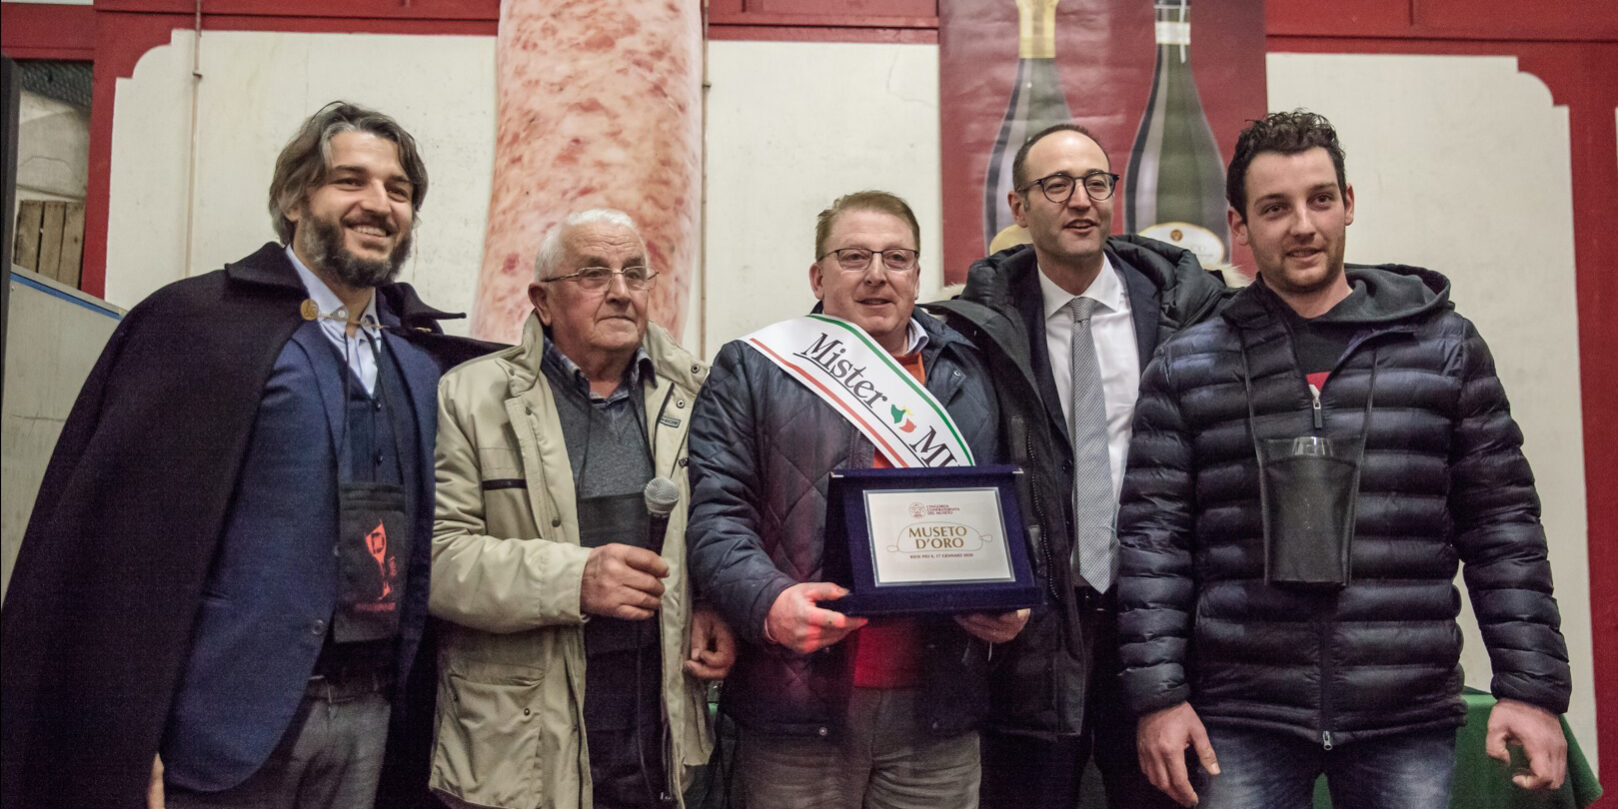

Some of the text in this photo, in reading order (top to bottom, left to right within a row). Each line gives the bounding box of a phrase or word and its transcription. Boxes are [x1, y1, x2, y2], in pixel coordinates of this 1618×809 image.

[801, 332, 888, 409] Mister
[908, 526, 968, 538] MUSETO
[915, 537, 965, 550] D'ORO
